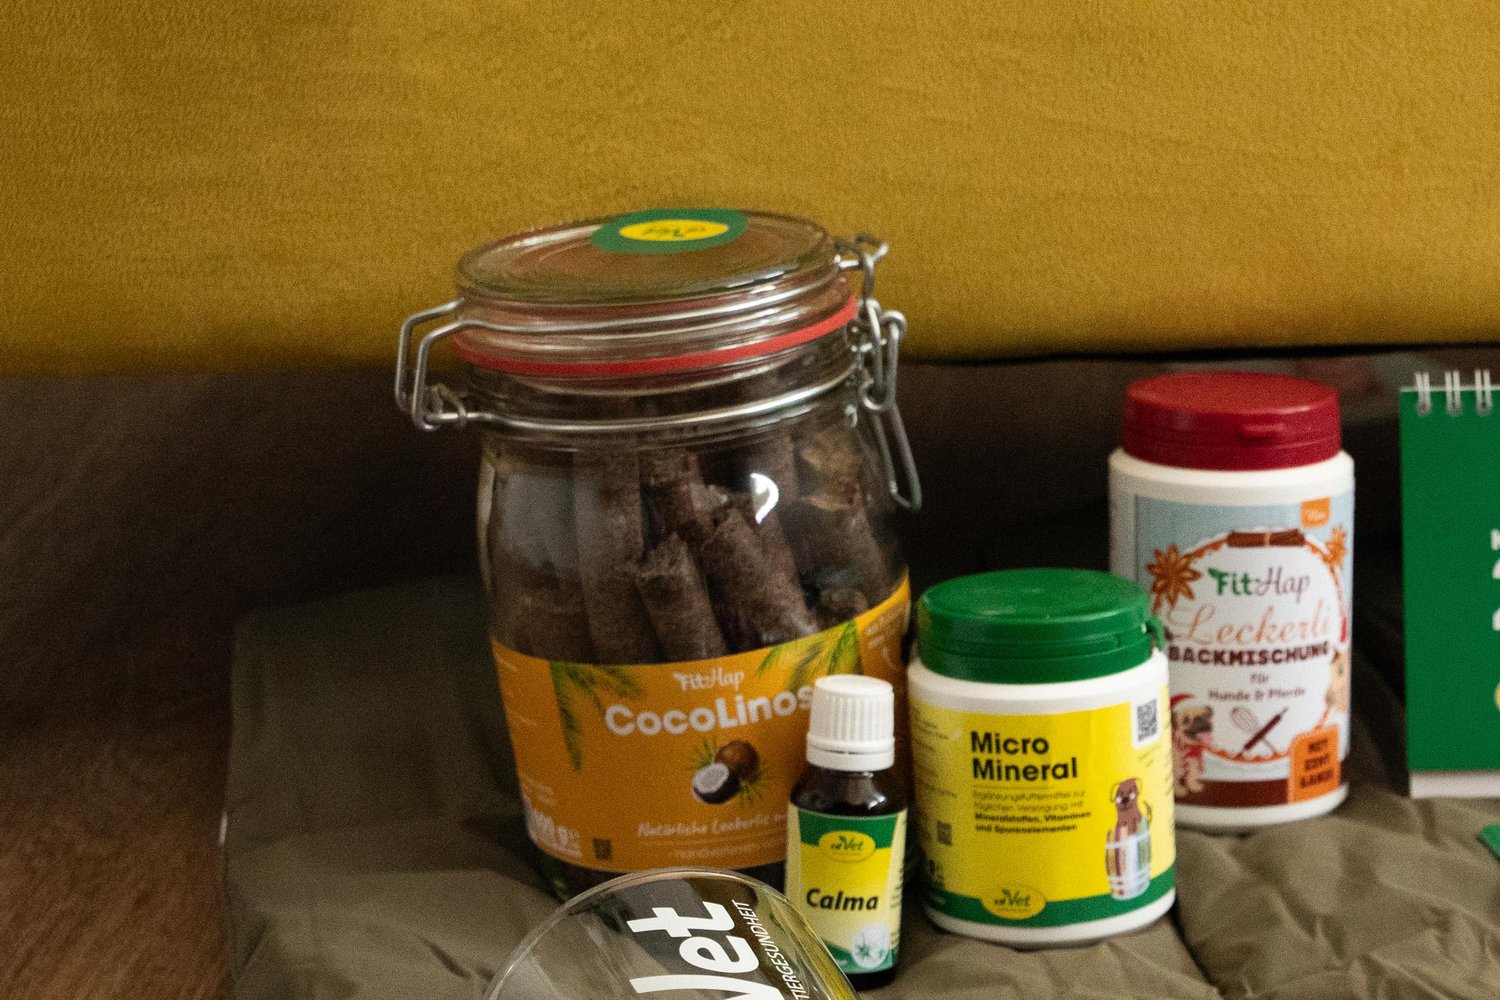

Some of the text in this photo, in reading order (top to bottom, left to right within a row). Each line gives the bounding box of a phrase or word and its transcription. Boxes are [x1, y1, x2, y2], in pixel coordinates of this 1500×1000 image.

[1166, 598, 1329, 645] Leckerli
[1169, 641, 1328, 666] BACKMISCHUNG
[605, 685, 814, 736] CocoLinos
[970, 731, 1049, 755] Micro
[973, 757, 1077, 781] Mineral
[806, 888, 879, 911] Calma
